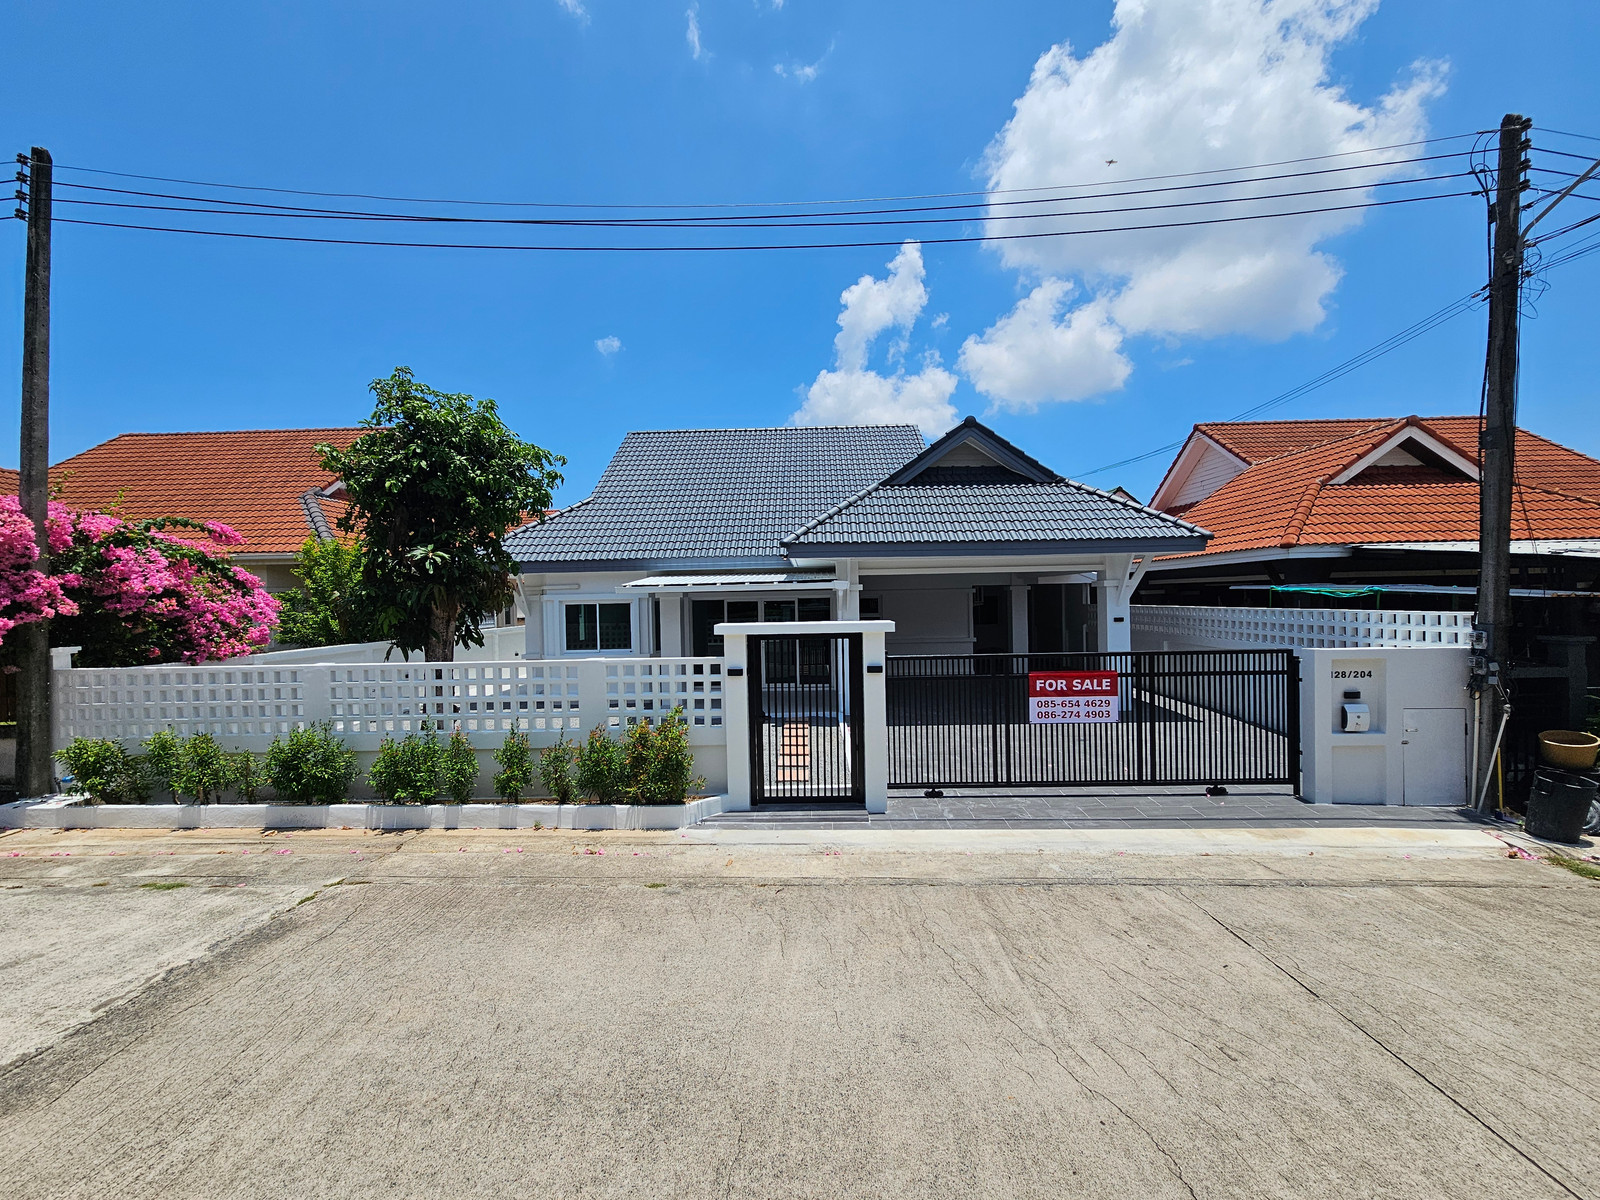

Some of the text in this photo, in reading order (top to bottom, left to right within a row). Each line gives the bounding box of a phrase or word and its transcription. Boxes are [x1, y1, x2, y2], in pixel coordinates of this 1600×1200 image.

[1035, 679, 1111, 691] FOR SALE
[1036, 699, 1111, 708] 085-654 4629
[1036, 710, 1111, 719] 086-274 4903
